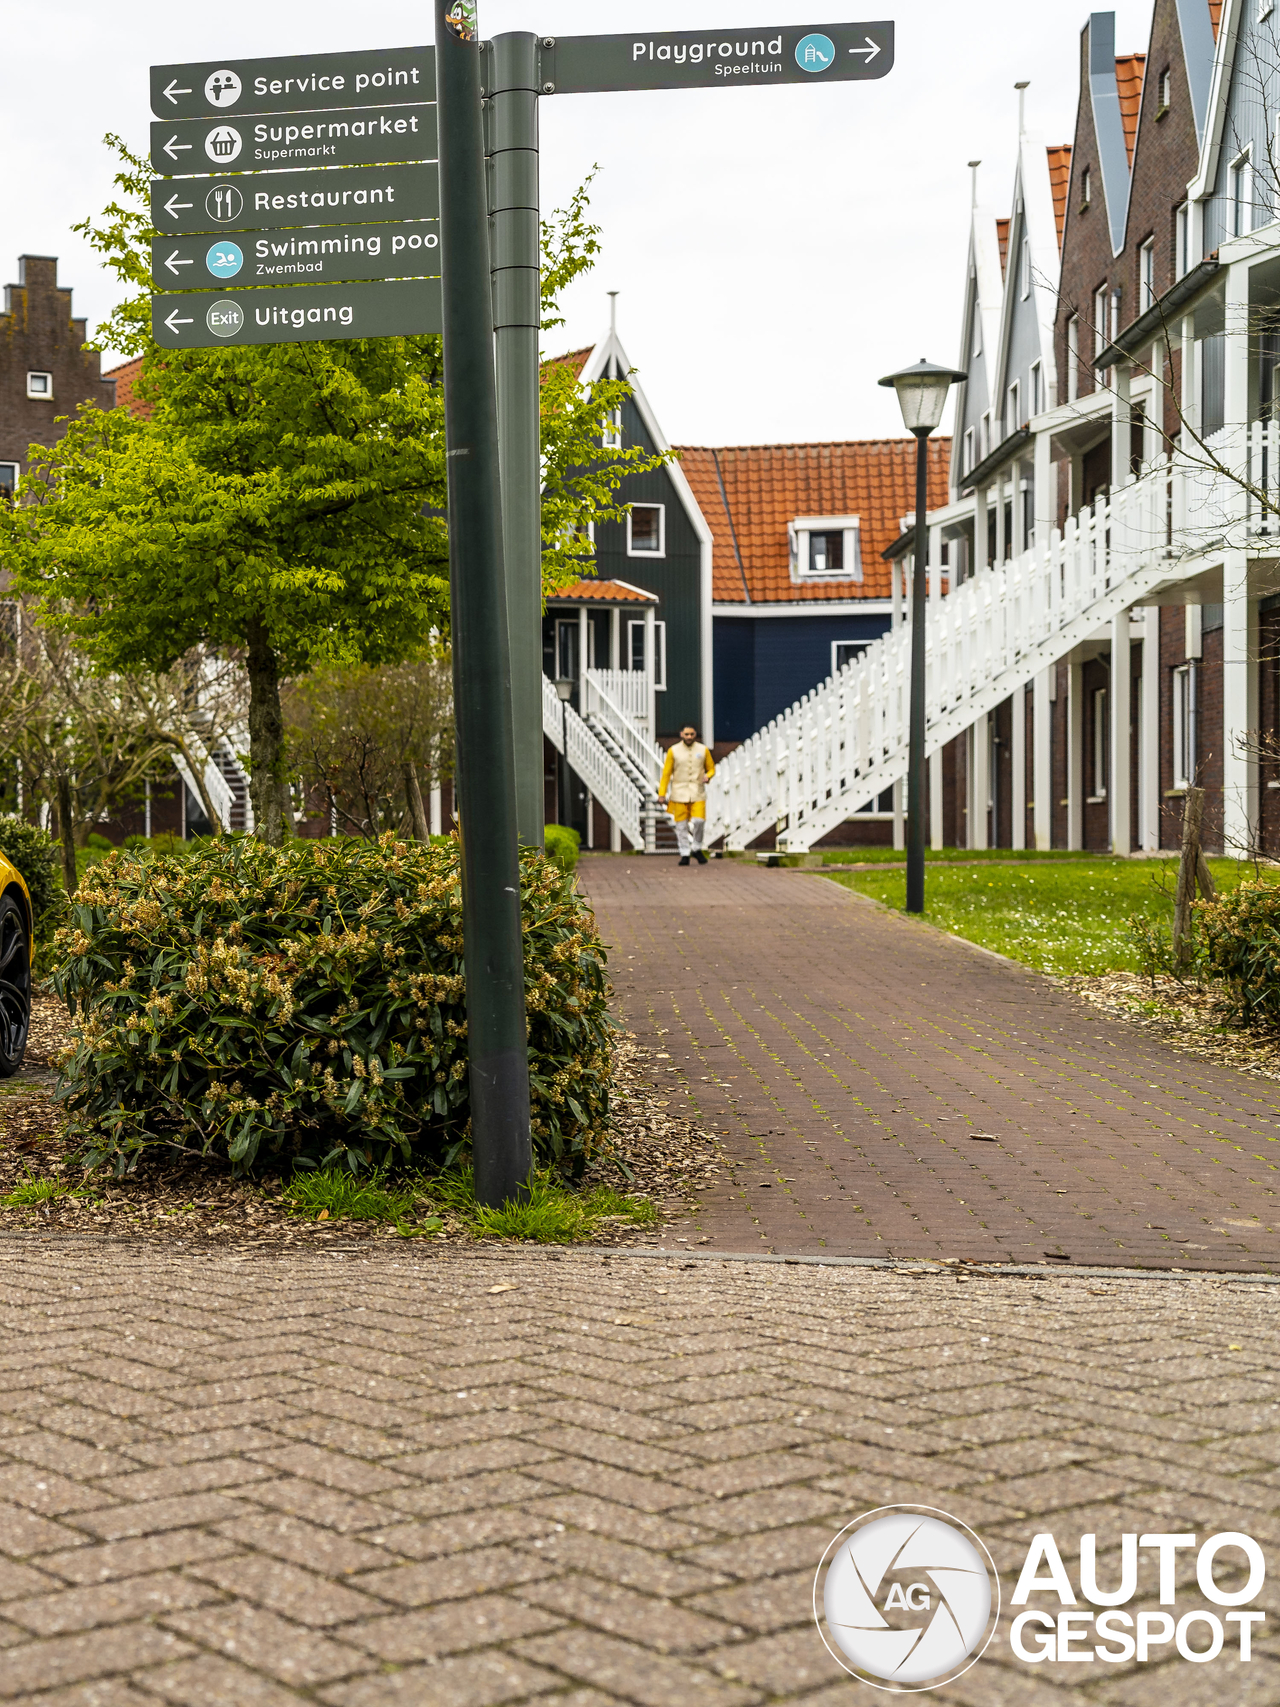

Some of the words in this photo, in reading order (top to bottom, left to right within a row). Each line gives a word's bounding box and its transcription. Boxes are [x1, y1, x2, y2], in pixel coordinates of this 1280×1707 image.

[632, 35, 782, 64] Playground
[254, 73, 345, 96] Service
[356, 67, 420, 93] point
[714, 62, 782, 77] Speeltuin
[254, 115, 419, 145] Supermarket
[254, 144, 336, 161] Supermarkt
[254, 185, 395, 211] Restaurant
[255, 234, 381, 258] Swimming
[392, 233, 439, 255] poo
[256, 260, 323, 275] Zwembad
[211, 311, 239, 326] Exit
[255, 305, 354, 329] Uitgang
